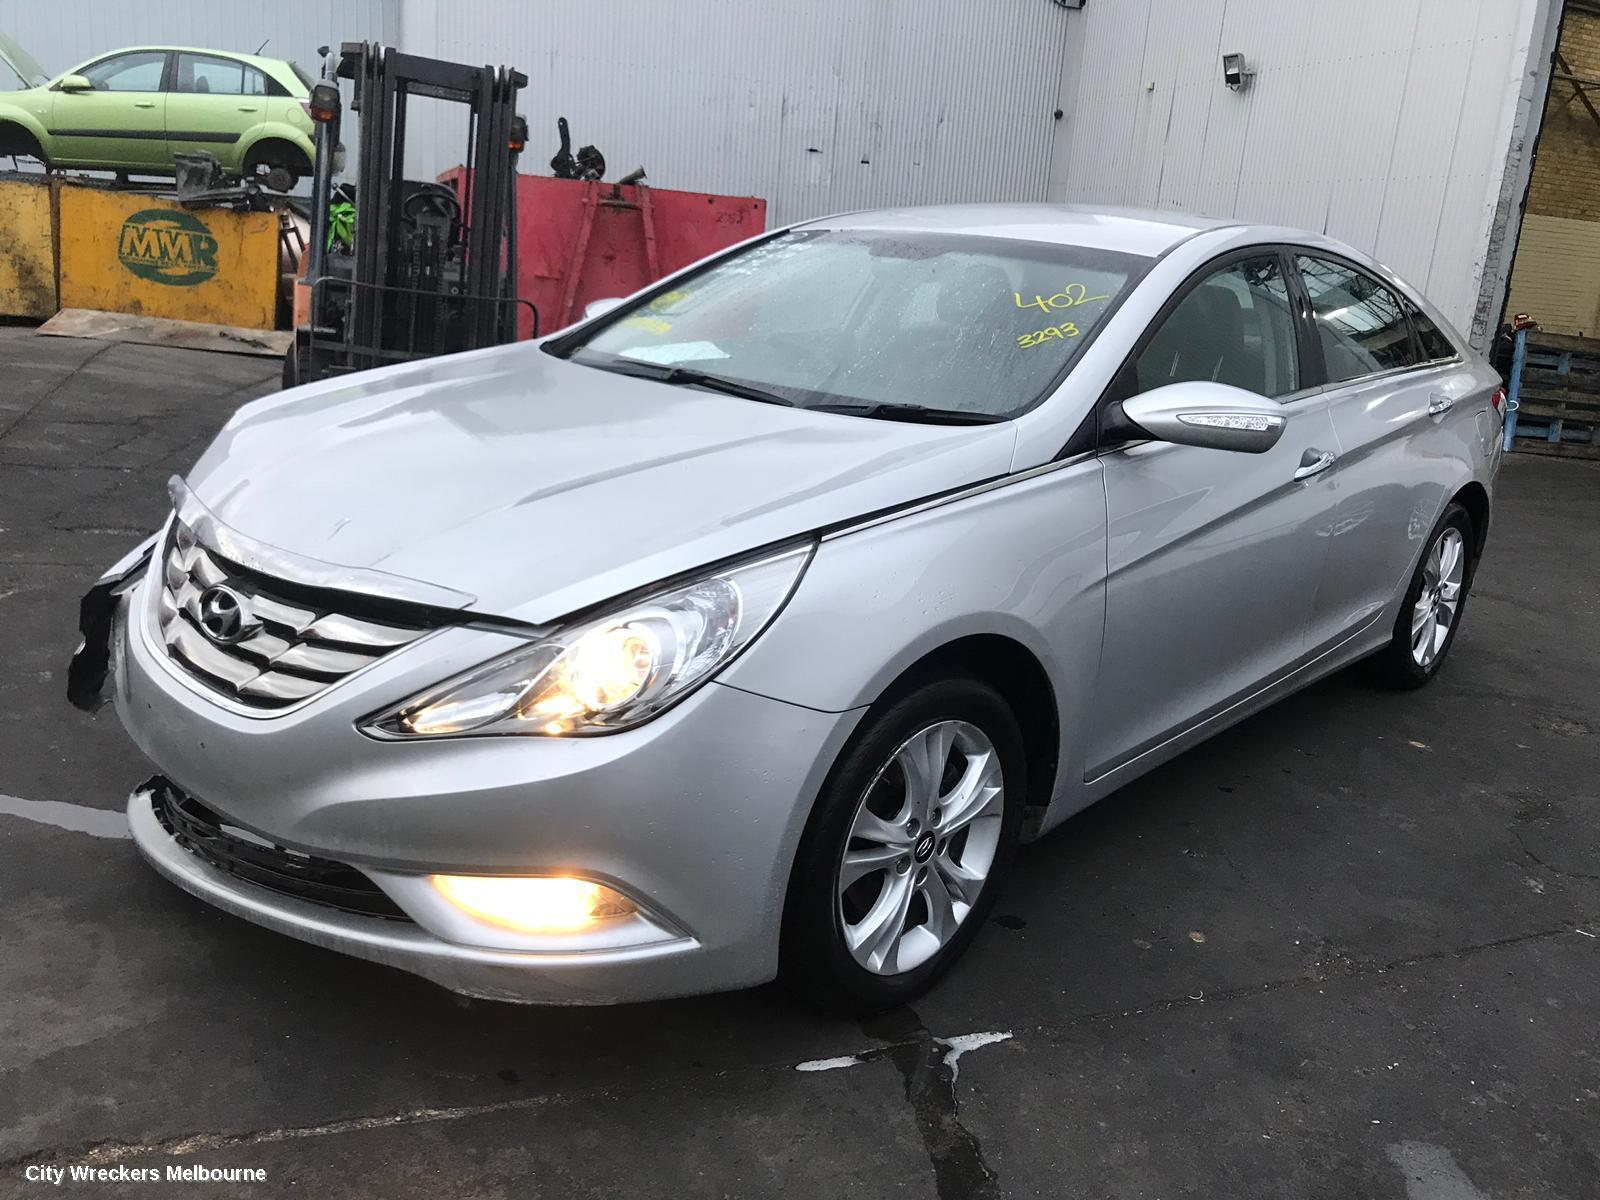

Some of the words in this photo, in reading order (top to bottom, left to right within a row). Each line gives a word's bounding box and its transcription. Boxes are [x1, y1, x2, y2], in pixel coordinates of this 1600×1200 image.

[118, 223, 219, 270] MMR
[1014, 283, 1110, 313] 402
[1015, 321, 1080, 349] 3293
